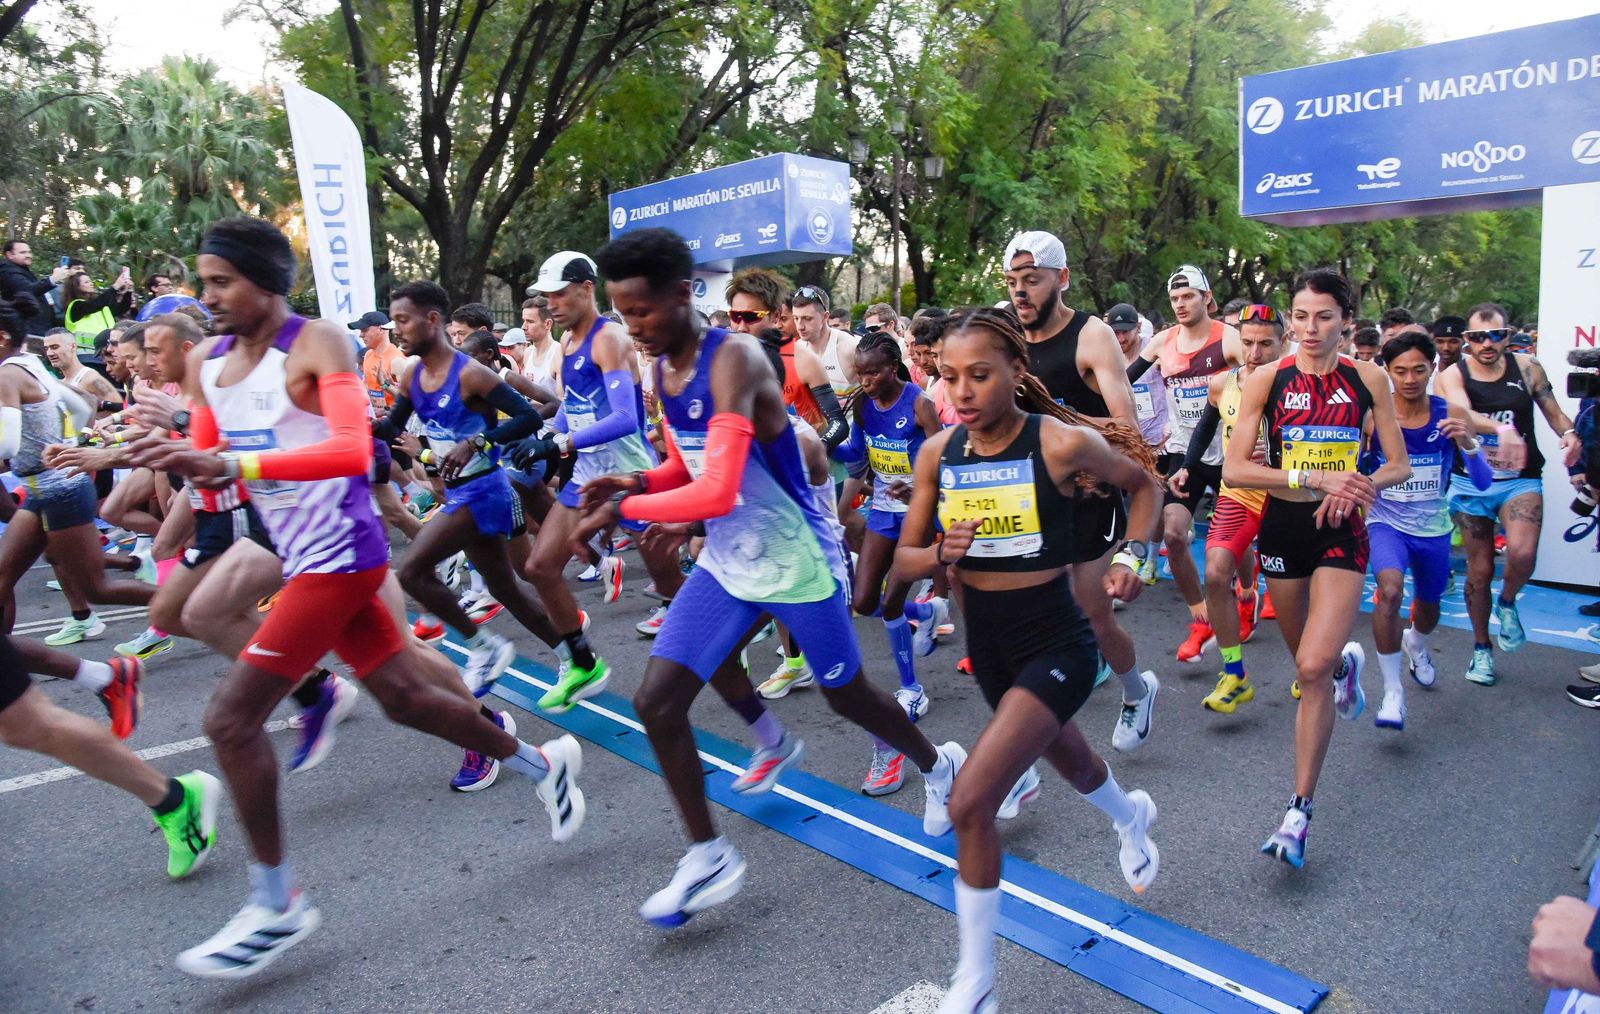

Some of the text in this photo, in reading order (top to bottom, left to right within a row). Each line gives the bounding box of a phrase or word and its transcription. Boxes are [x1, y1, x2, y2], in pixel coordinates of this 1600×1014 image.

[1294, 85, 1403, 121] ZURICH
[1418, 60, 1557, 104] MARATÓN
[630, 202, 669, 221] ZURICH
[673, 190, 720, 212] MARATÓN
[721, 187, 736, 202] DE
[737, 178, 781, 198] SEVILLA
[1185, 388, 1208, 396] ZURIC
[1284, 392, 1311, 406] DKR
[1309, 430, 1351, 439] ZURICH
[875, 441, 900, 450] ZURICH
[1308, 448, 1333, 458] F-116
[959, 467, 1019, 484] ZURICH
[963, 498, 996, 511] F-121
[1260, 554, 1285, 569] DKR
